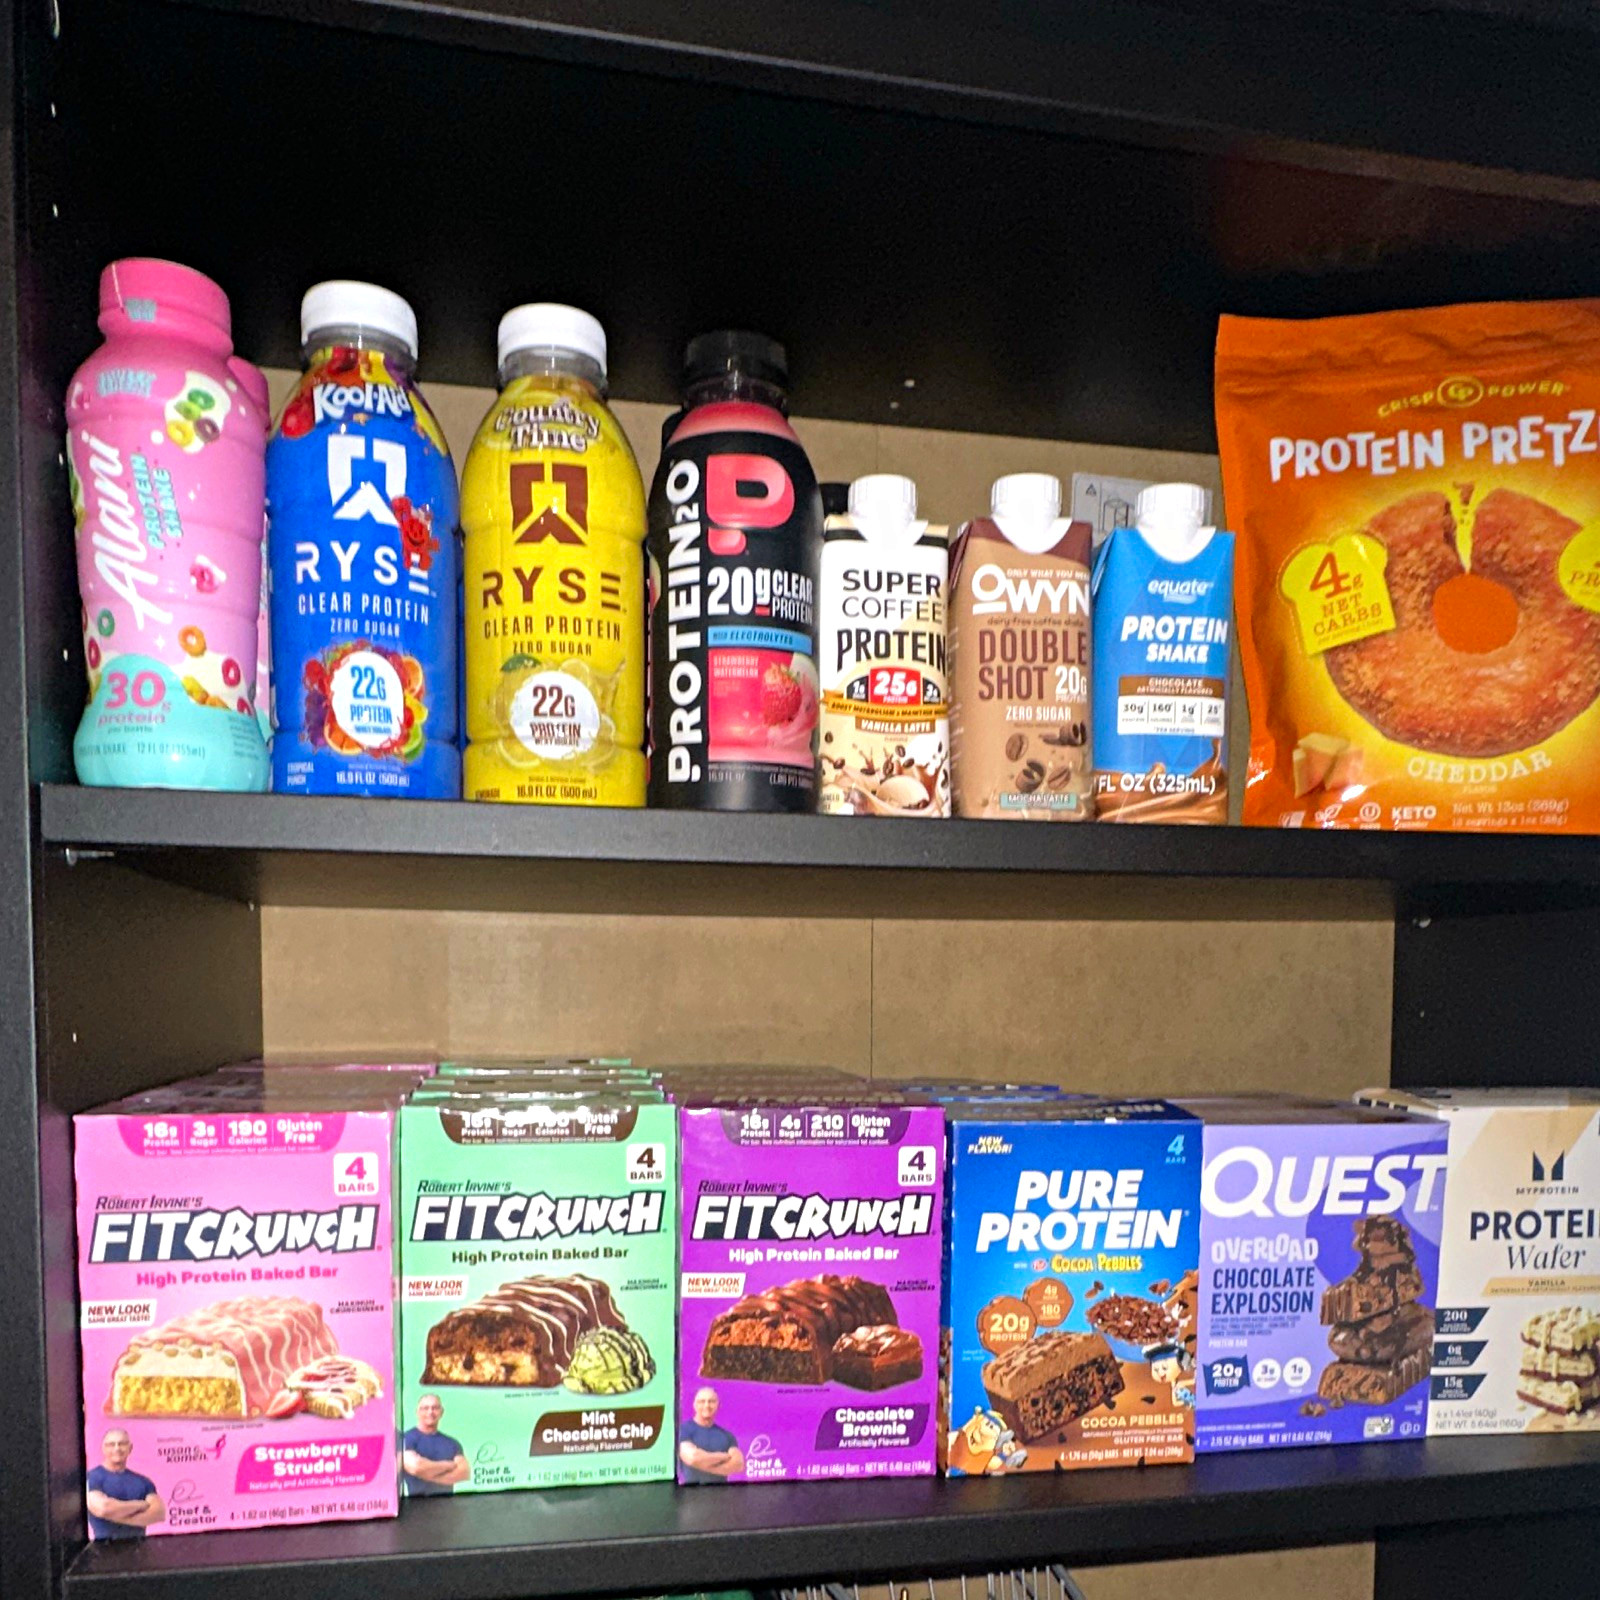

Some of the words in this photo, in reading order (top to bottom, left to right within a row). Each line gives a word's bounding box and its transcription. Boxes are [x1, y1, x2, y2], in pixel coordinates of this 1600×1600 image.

[1488, 381, 1565, 396] POWER
[495, 401, 600, 438] Country
[511, 425, 588, 452] Time
[1269, 429, 1444, 483] PROTEIN
[1462, 409, 1600, 467] PRETZ
[130, 453, 166, 549] PROTEIN
[152, 468, 183, 538] SHAKE
[81, 430, 173, 630] Alani
[482, 566, 621, 612] RYSE
[707, 566, 771, 616] 20g
[772, 569, 813, 604] CLEAR
[842, 568, 941, 598] SUPER
[971, 563, 1090, 616] OWYN
[1147, 578, 1208, 599] equate
[298, 592, 351, 616] CLEAR
[361, 593, 430, 627] PROTEIN
[772, 597, 813, 625] PROTEIN
[841, 596, 943, 625] COFFEE
[1322, 592, 1362, 618] NET
[330, 617, 358, 634] ZERO
[363, 618, 400, 638] SUGAR
[484, 616, 533, 640] CLEAR
[545, 616, 621, 642] PROTEIN
[1119, 614, 1229, 645] PROTEIN
[512, 640, 543, 654] ZERO
[550, 641, 592, 657] SUGAR
[837, 627, 946, 678] PROTEIN
[979, 628, 1087, 665] DOUBLE
[1145, 643, 1210, 664] SHAKE
[978, 665, 1048, 700] SHOT
[1148, 677, 1203, 687] CHOCOLATE
[98, 712, 166, 728] protein
[1005, 705, 1033, 721] ZERO
[1036, 706, 1071, 721] SUGAR
[861, 720, 902, 733] VANILLA
[904, 721, 931, 732] LATTE
[1407, 750, 1553, 784] CHEDDAR
[535, 786, 545, 797] FL
[546, 786, 556, 797] OZ
[1099, 774, 1117, 793] FL
[1120, 772, 1146, 793] OZ
[1149, 773, 1216, 796] (325mL)
[1392, 805, 1437, 820] KETO
[276, 1119, 323, 1132] Gluten
[740, 1129, 771, 1138] Protein
[858, 1127, 884, 1138] Free
[811, 1114, 844, 1130] 210
[852, 1114, 891, 1127] Gluten
[143, 1138, 180, 1147] Protein
[284, 1131, 316, 1144] Free
[1167, 1134, 1185, 1155] 4
[345, 1156, 366, 1179] 4
[636, 1147, 656, 1168] 4
[908, 1150, 926, 1171] 4
[417, 1179, 462, 1193] ROBERT
[465, 1178, 512, 1192] IRVINE'S
[630, 1171, 662, 1180] BARS
[698, 1179, 742, 1193] ROBERT
[743, 1179, 788, 1192] IRVINE'S
[901, 1173, 933, 1183] BARS
[1200, 1145, 1449, 1218] QUEST
[338, 1182, 375, 1193] BARS
[1014, 1169, 1144, 1211] PURE
[1516, 1186, 1579, 1195] MYPROTEIN
[95, 1195, 148, 1210] ROBERT
[149, 1194, 203, 1209] IRVINE'S
[409, 1190, 667, 1242] FITCRUNCH
[690, 1191, 936, 1242] FITCRUNCH
[88, 1203, 380, 1264] FITCRUNCH
[975, 1209, 1183, 1253] PROTEIN
[452, 1251, 487, 1266] High
[491, 1249, 549, 1262] Protein
[552, 1247, 600, 1260] Baked
[603, 1246, 629, 1259] Bar
[729, 1249, 764, 1265] High
[766, 1248, 822, 1262] Protein
[824, 1247, 871, 1260] Baked
[874, 1247, 899, 1260] Bar
[1211, 1233, 1319, 1264] OVERLOAD
[1507, 1242, 1587, 1270] Wafer
[1051, 1254, 1094, 1273] COCOA
[1097, 1253, 1143, 1271] PEBBLES
[136, 1271, 177, 1288] High
[181, 1269, 247, 1284] Protein
[251, 1267, 305, 1281] Baked
[309, 1265, 339, 1279] Bar
[408, 1280, 432, 1290] NEW
[434, 1279, 463, 1289] LOOK
[687, 1277, 711, 1286] NEW
[713, 1277, 740, 1286] LOOK
[1212, 1266, 1316, 1289] CHOCOLATE
[87, 1305, 115, 1316] NEW
[118, 1303, 151, 1315] LOOK
[1211, 1291, 1314, 1315] EXPLOSION
[990, 1312, 1030, 1333] 20g
[1443, 1310, 1468, 1322] 200
[990, 1333, 1027, 1342] PROTEIN
[1212, 1363, 1243, 1378] 20g
[581, 1411, 616, 1426] Mint
[835, 1406, 914, 1423] Chocolate
[1081, 1416, 1127, 1429] COCOA
[1130, 1413, 1184, 1427] PEBBLES
[542, 1424, 618, 1443] Chocolate
[620, 1422, 653, 1442] Chip
[843, 1422, 907, 1437] Brownie
[1146, 1435, 1165, 1443] FREE
[254, 1442, 358, 1462] Strawberry
[273, 1458, 341, 1475] Strudel
[746, 1458, 773, 1468] Chef
[746, 1467, 787, 1477] Creator
[169, 1506, 199, 1516] Chef
[169, 1515, 218, 1526] Creator
